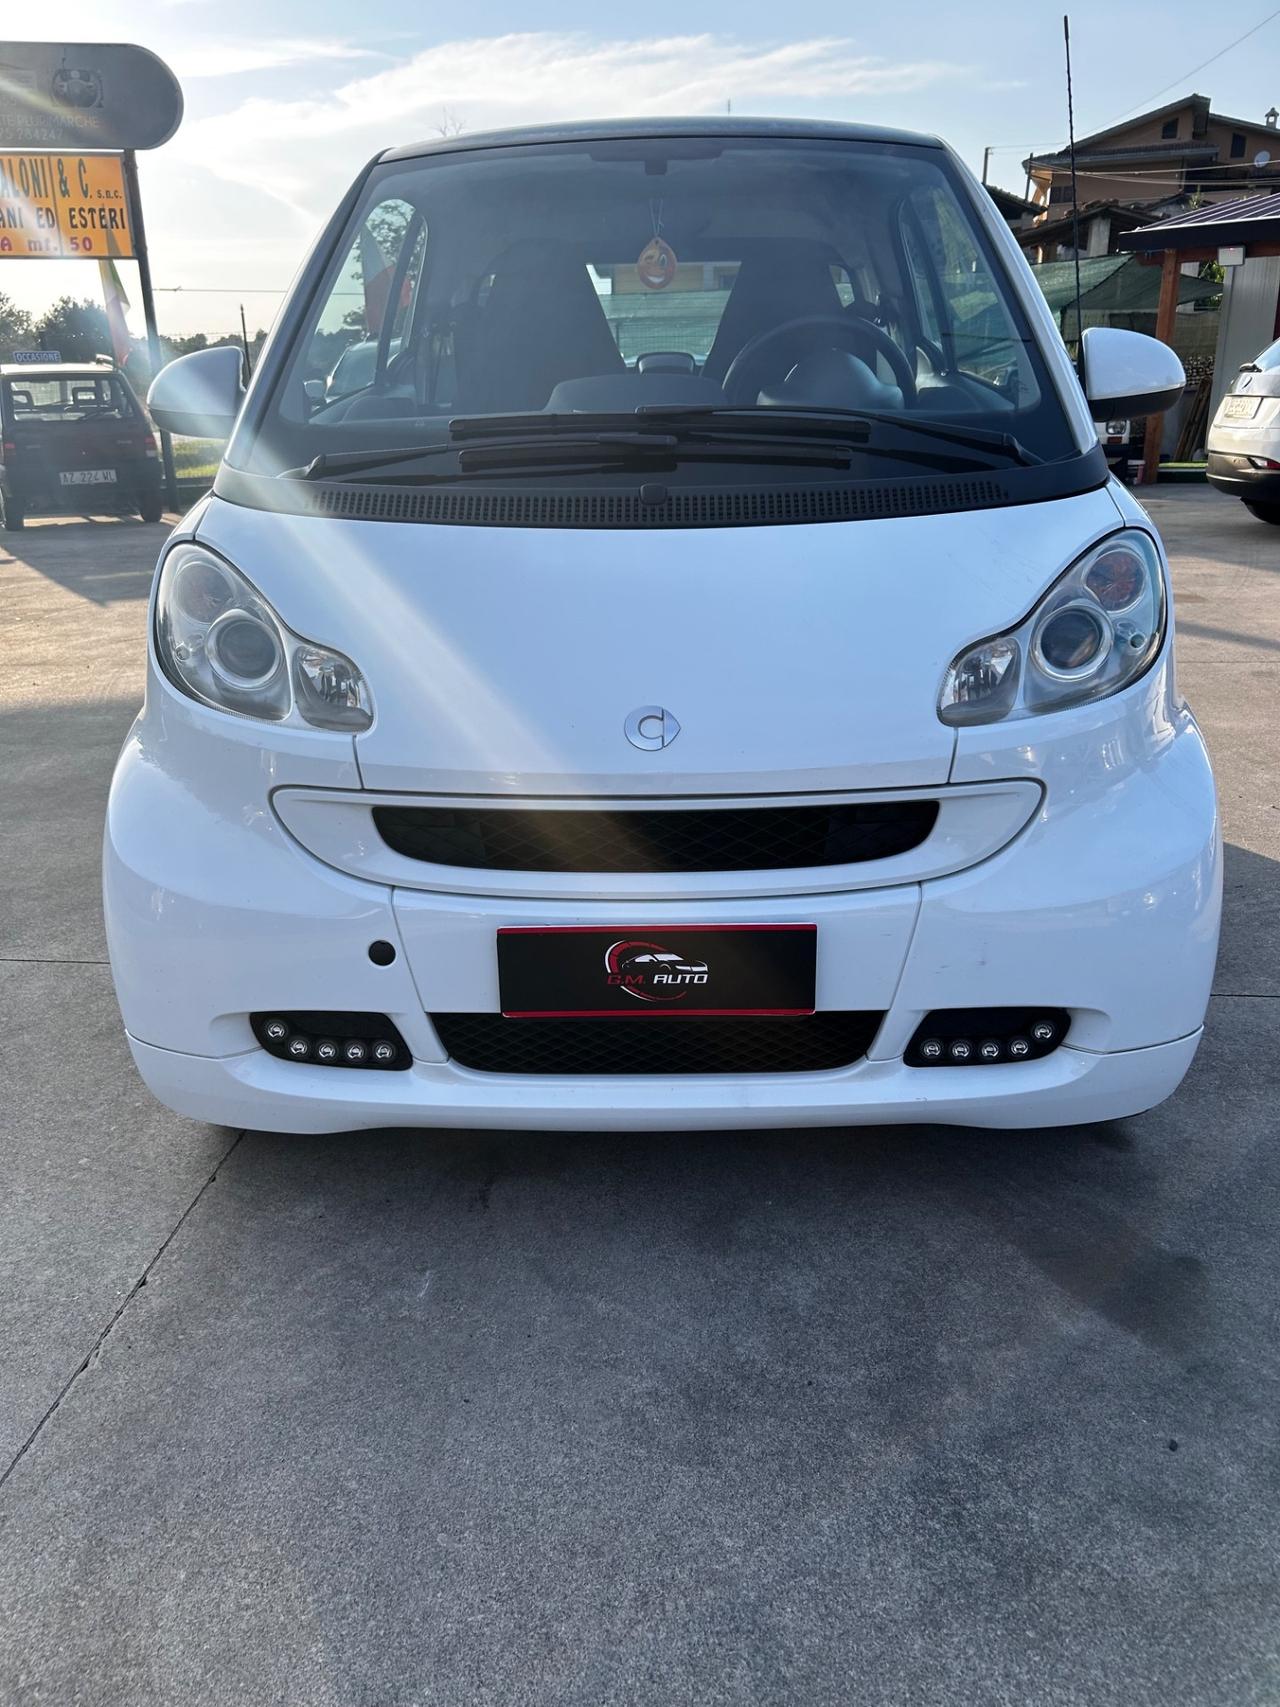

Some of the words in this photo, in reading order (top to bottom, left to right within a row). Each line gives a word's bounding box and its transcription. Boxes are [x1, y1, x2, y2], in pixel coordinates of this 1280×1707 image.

[36, 207, 56, 229] ED
[69, 207, 126, 229] ESTERI
[69, 236, 93, 251] 50
[16, 353, 60, 362] OCCASIONE
[653, 974, 708, 984] AUTO
